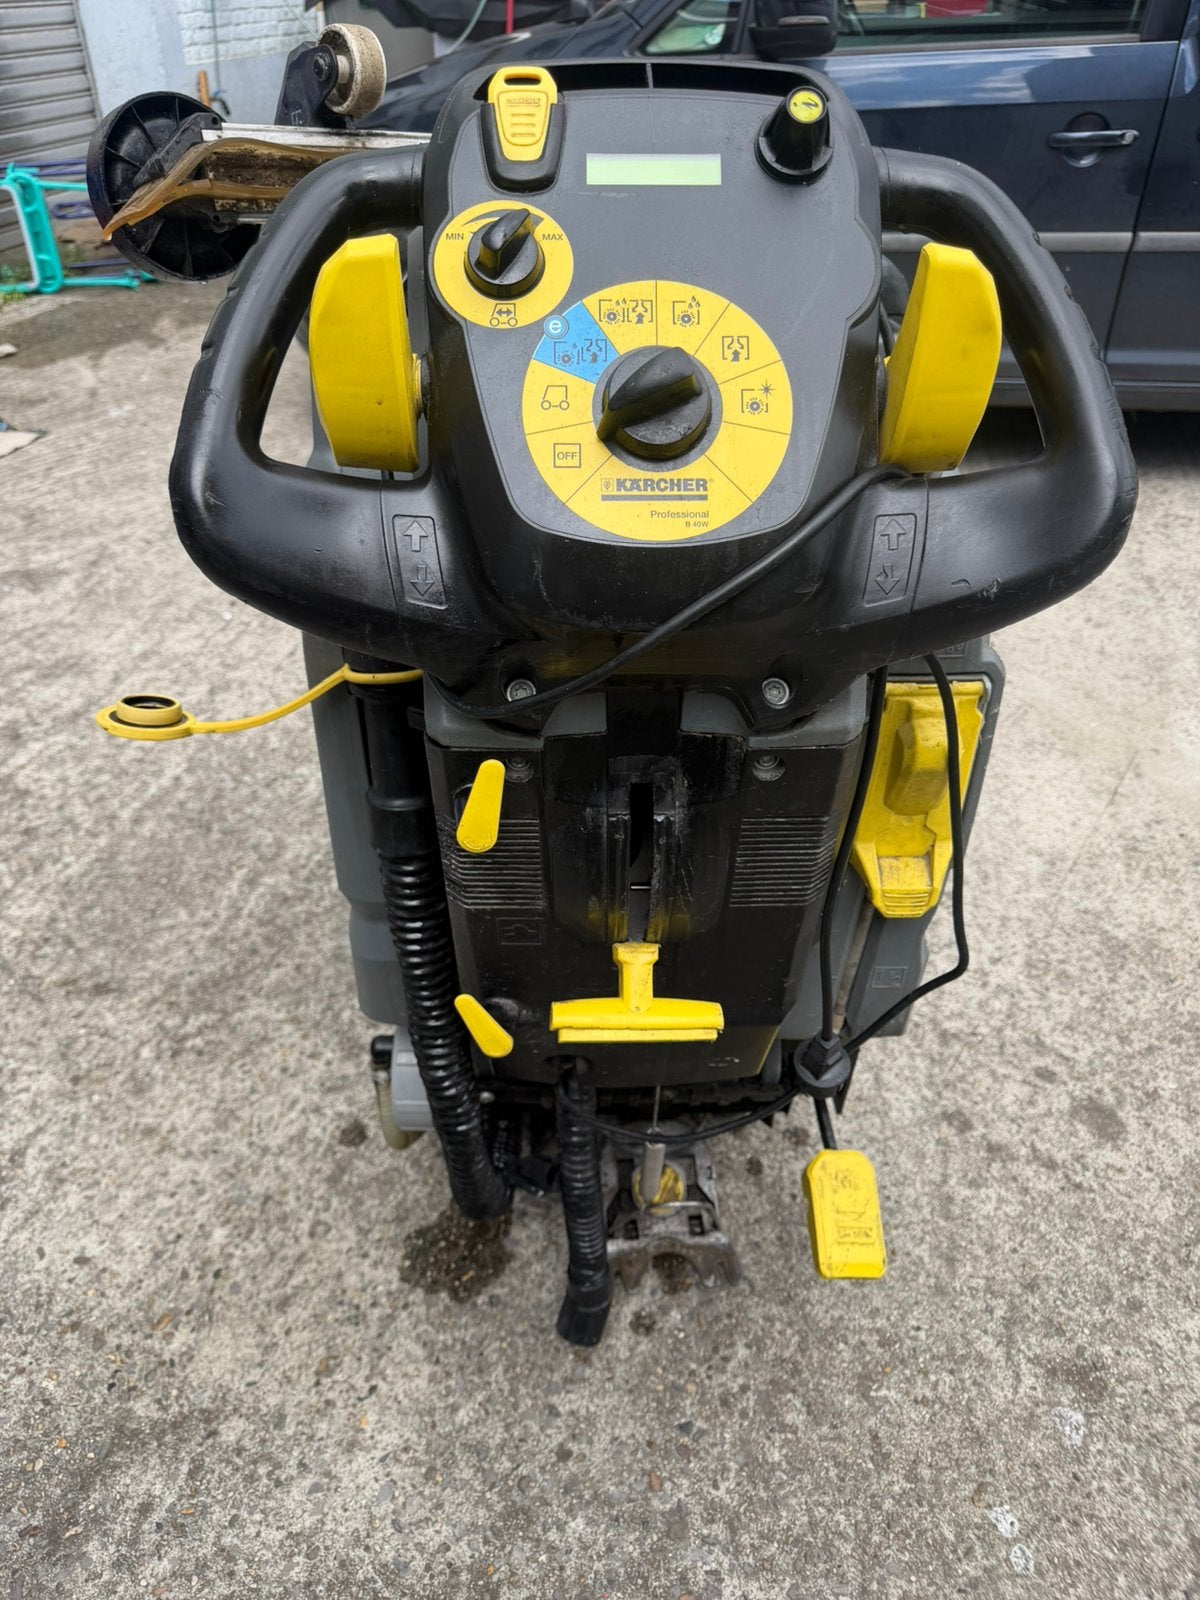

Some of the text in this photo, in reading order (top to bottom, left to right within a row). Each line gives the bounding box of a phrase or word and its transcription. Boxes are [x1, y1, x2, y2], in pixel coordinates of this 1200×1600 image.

[445, 232, 465, 241] MIN
[542, 232, 564, 241] MAX
[556, 451, 578, 461] OFF
[616, 478, 708, 492] KÄRCHER
[650, 510, 709, 518] Professional
